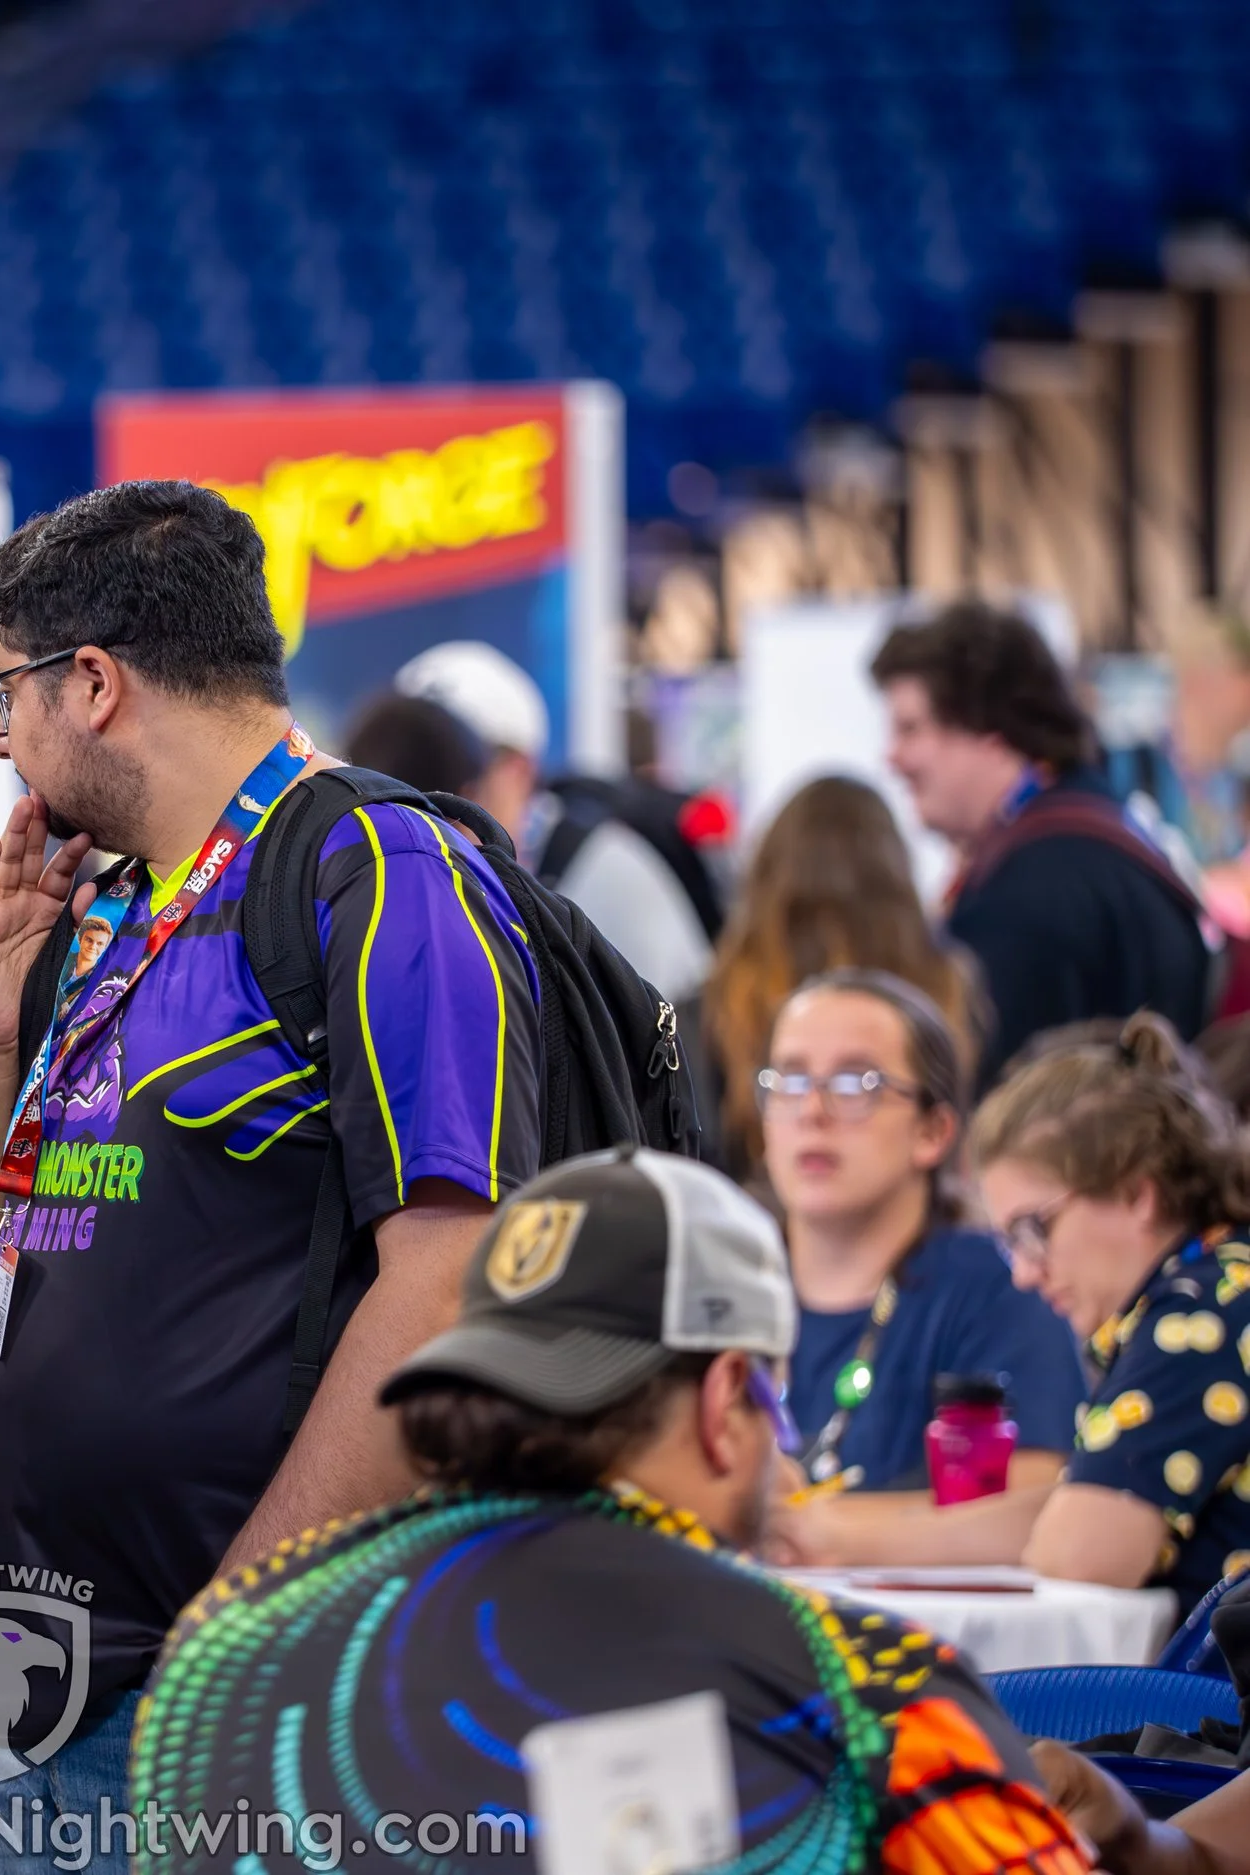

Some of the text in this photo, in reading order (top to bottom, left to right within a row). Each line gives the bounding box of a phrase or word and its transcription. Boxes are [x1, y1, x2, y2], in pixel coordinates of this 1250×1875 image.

[183, 868, 200, 891] THE
[191, 838, 233, 895] BOYS
[33, 1140, 145, 1203] MONSTER
